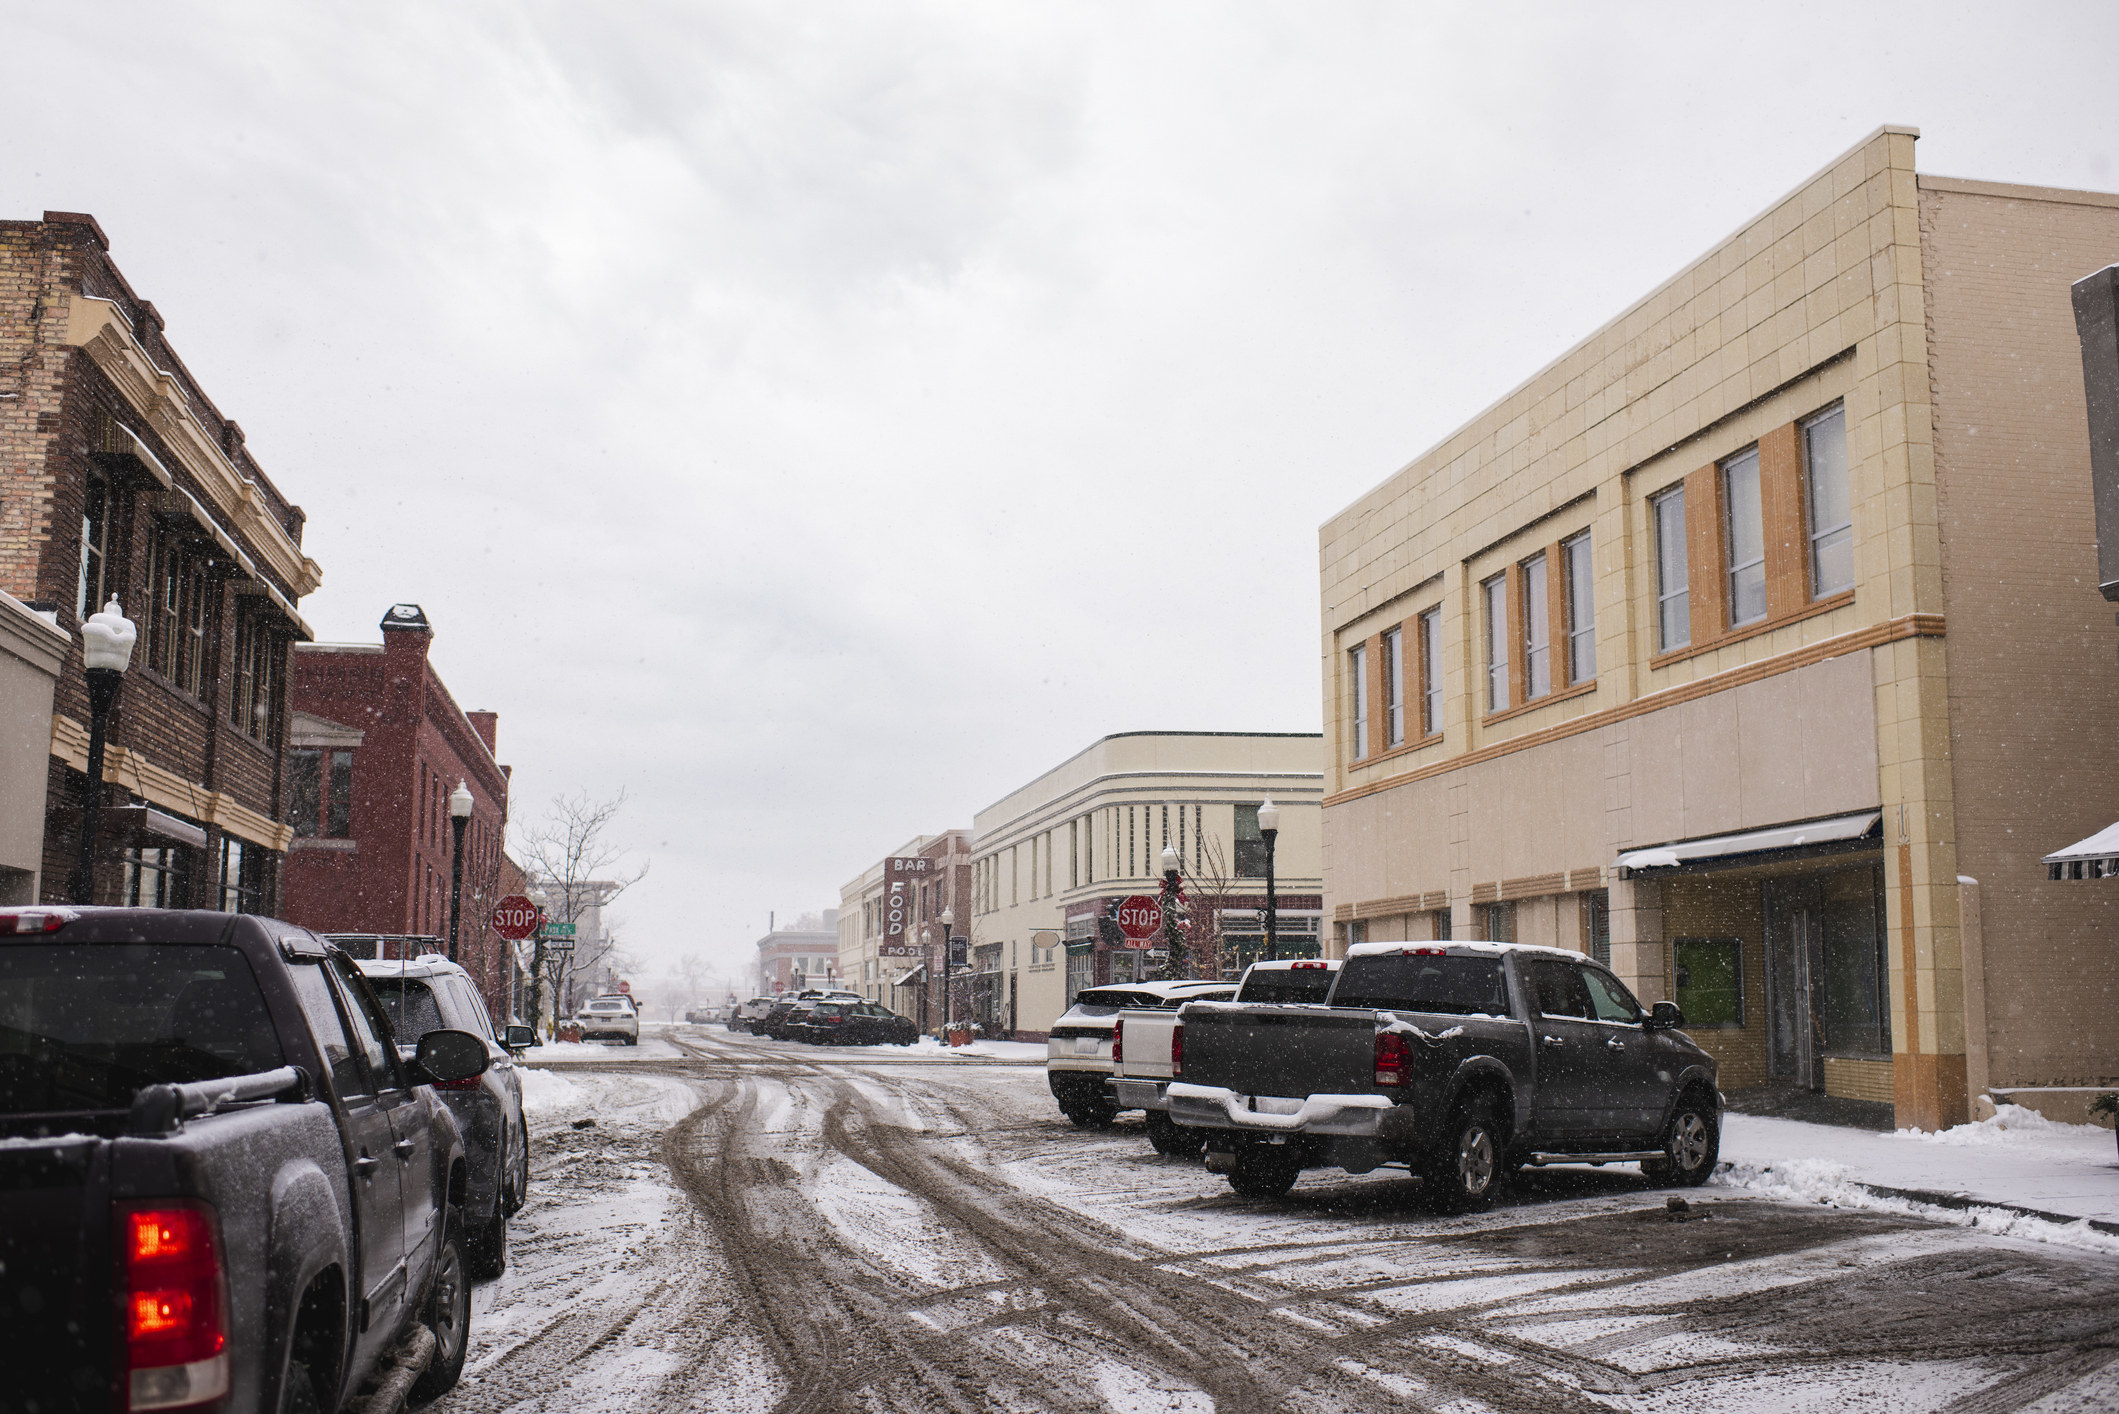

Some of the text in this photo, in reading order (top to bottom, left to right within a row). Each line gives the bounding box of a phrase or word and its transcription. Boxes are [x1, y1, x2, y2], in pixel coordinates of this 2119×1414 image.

[894, 859, 926, 871] BAR
[889, 882, 905, 935] FOOD
[1121, 908, 1159, 926] STOP
[495, 909, 535, 927] STOP
[888, 946, 924, 956] POOL
